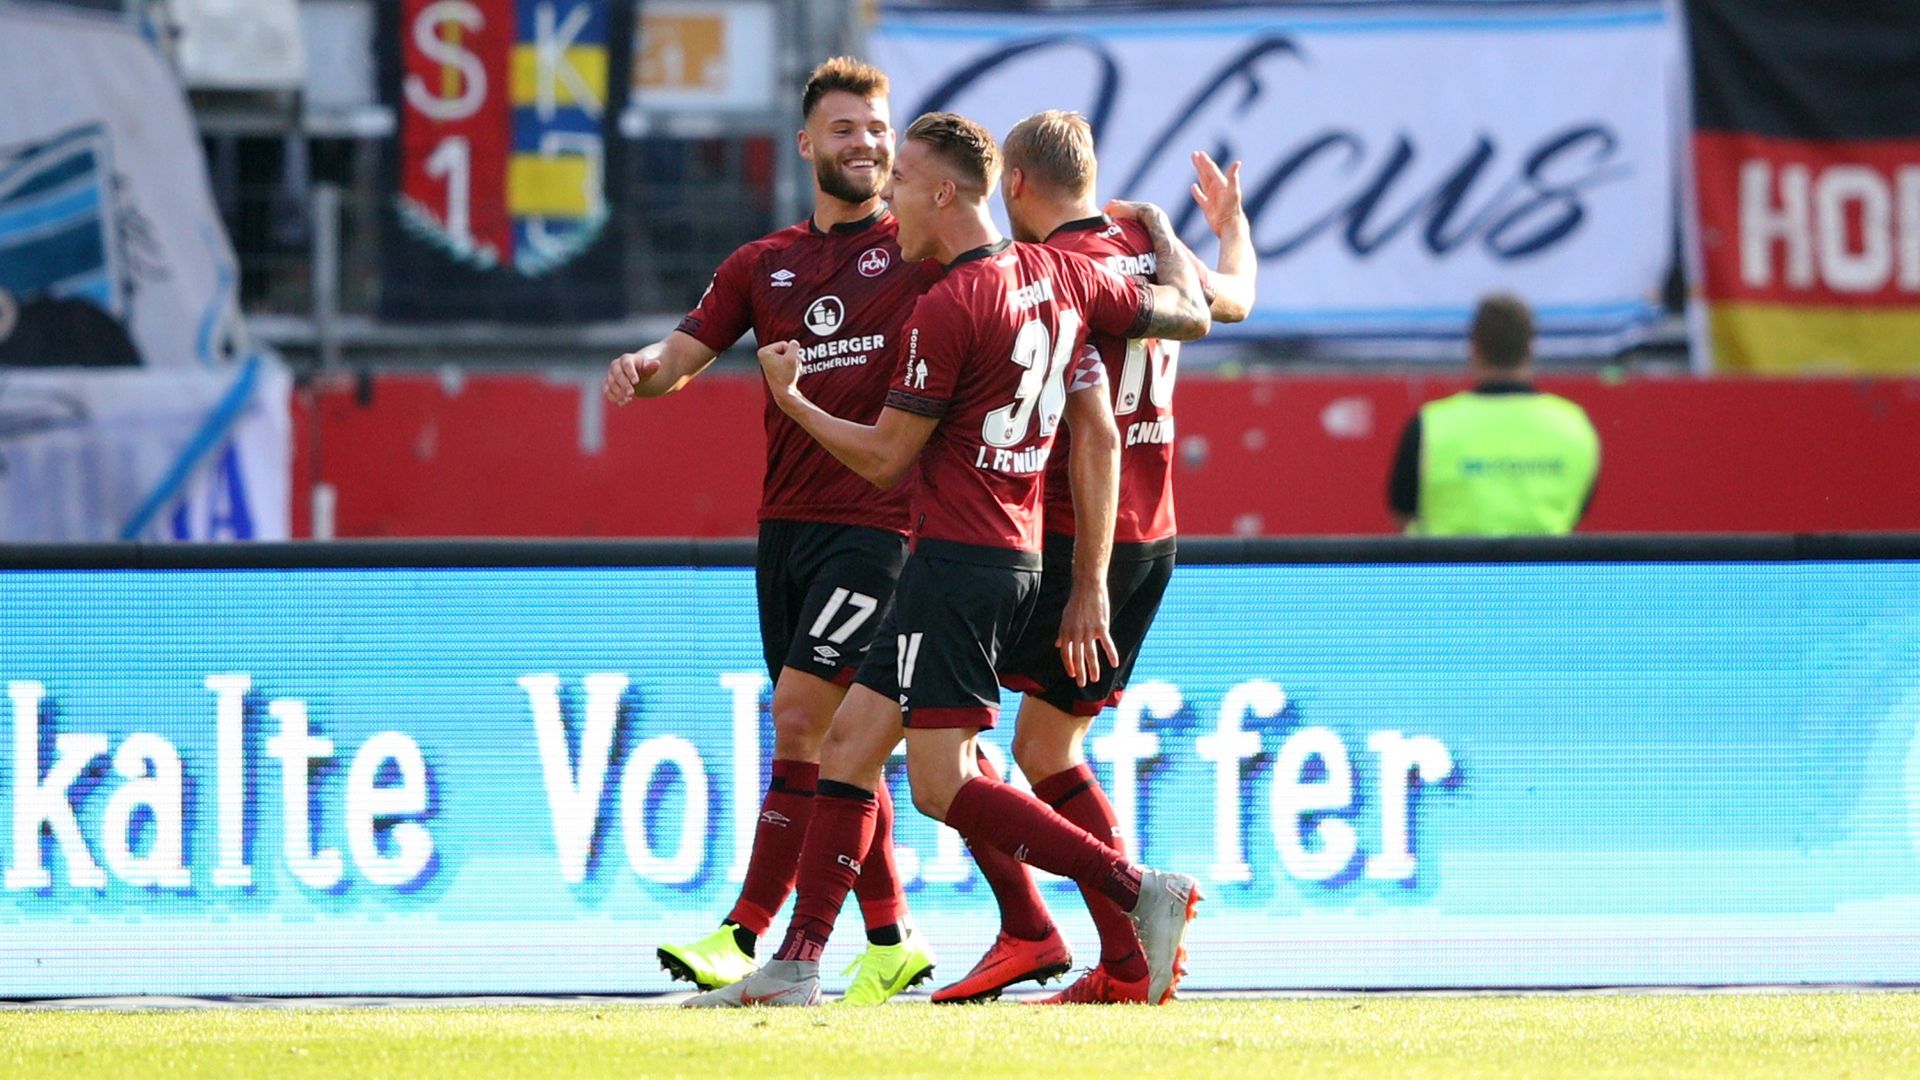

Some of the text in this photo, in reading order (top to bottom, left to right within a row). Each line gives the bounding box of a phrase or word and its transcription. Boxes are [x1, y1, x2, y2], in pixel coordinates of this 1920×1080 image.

[861, 257, 886, 272] FCN
[796, 334, 885, 362] RNBERGER
[799, 354, 868, 377] RSICHERUNG
[808, 587, 878, 645] 17
[4, 671, 1454, 889] kalte Volffer
